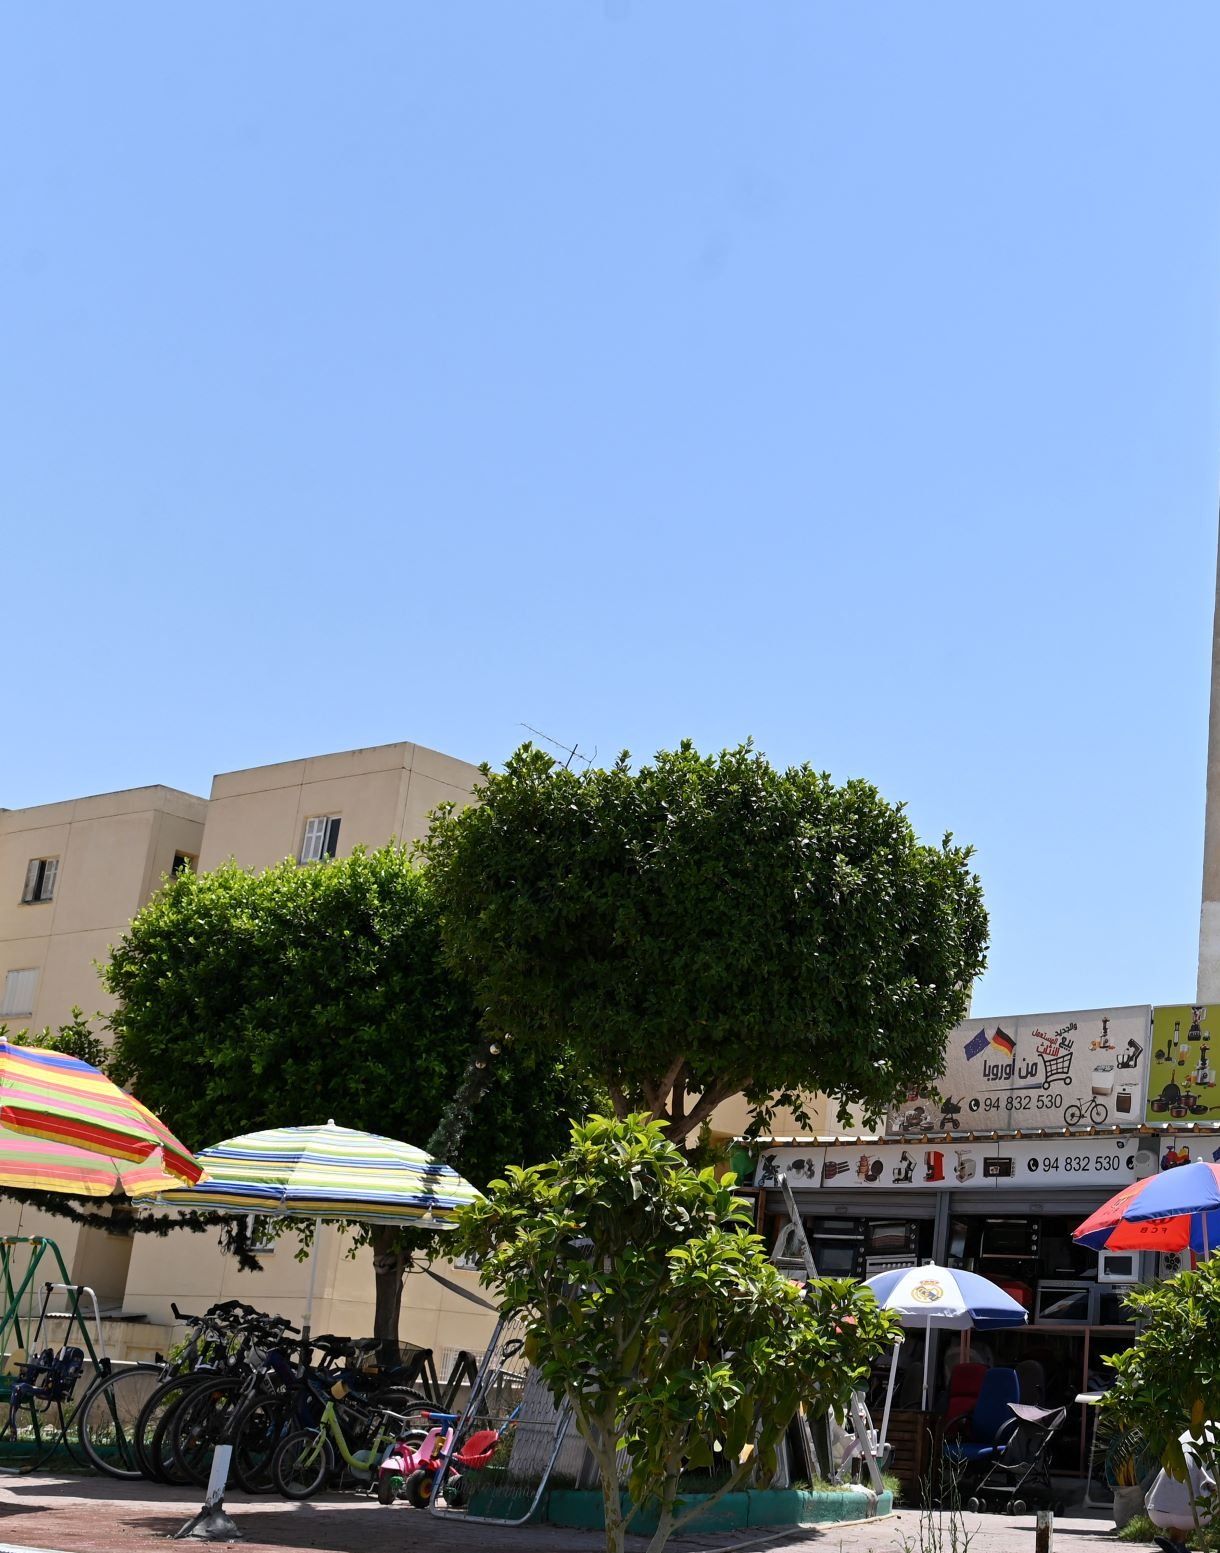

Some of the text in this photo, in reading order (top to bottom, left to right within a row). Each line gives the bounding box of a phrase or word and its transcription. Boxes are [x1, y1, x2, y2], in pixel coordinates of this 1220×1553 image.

[1032, 1028, 1059, 1045] المستعمل
[1055, 1022, 1078, 1037] والجديد
[1059, 1036, 1074, 1052] بيع
[983, 1052, 1038, 1082] من أوروبا
[984, 1093, 1063, 1112] 94 832 530
[1042, 1155, 1120, 1172] 94 832 530
